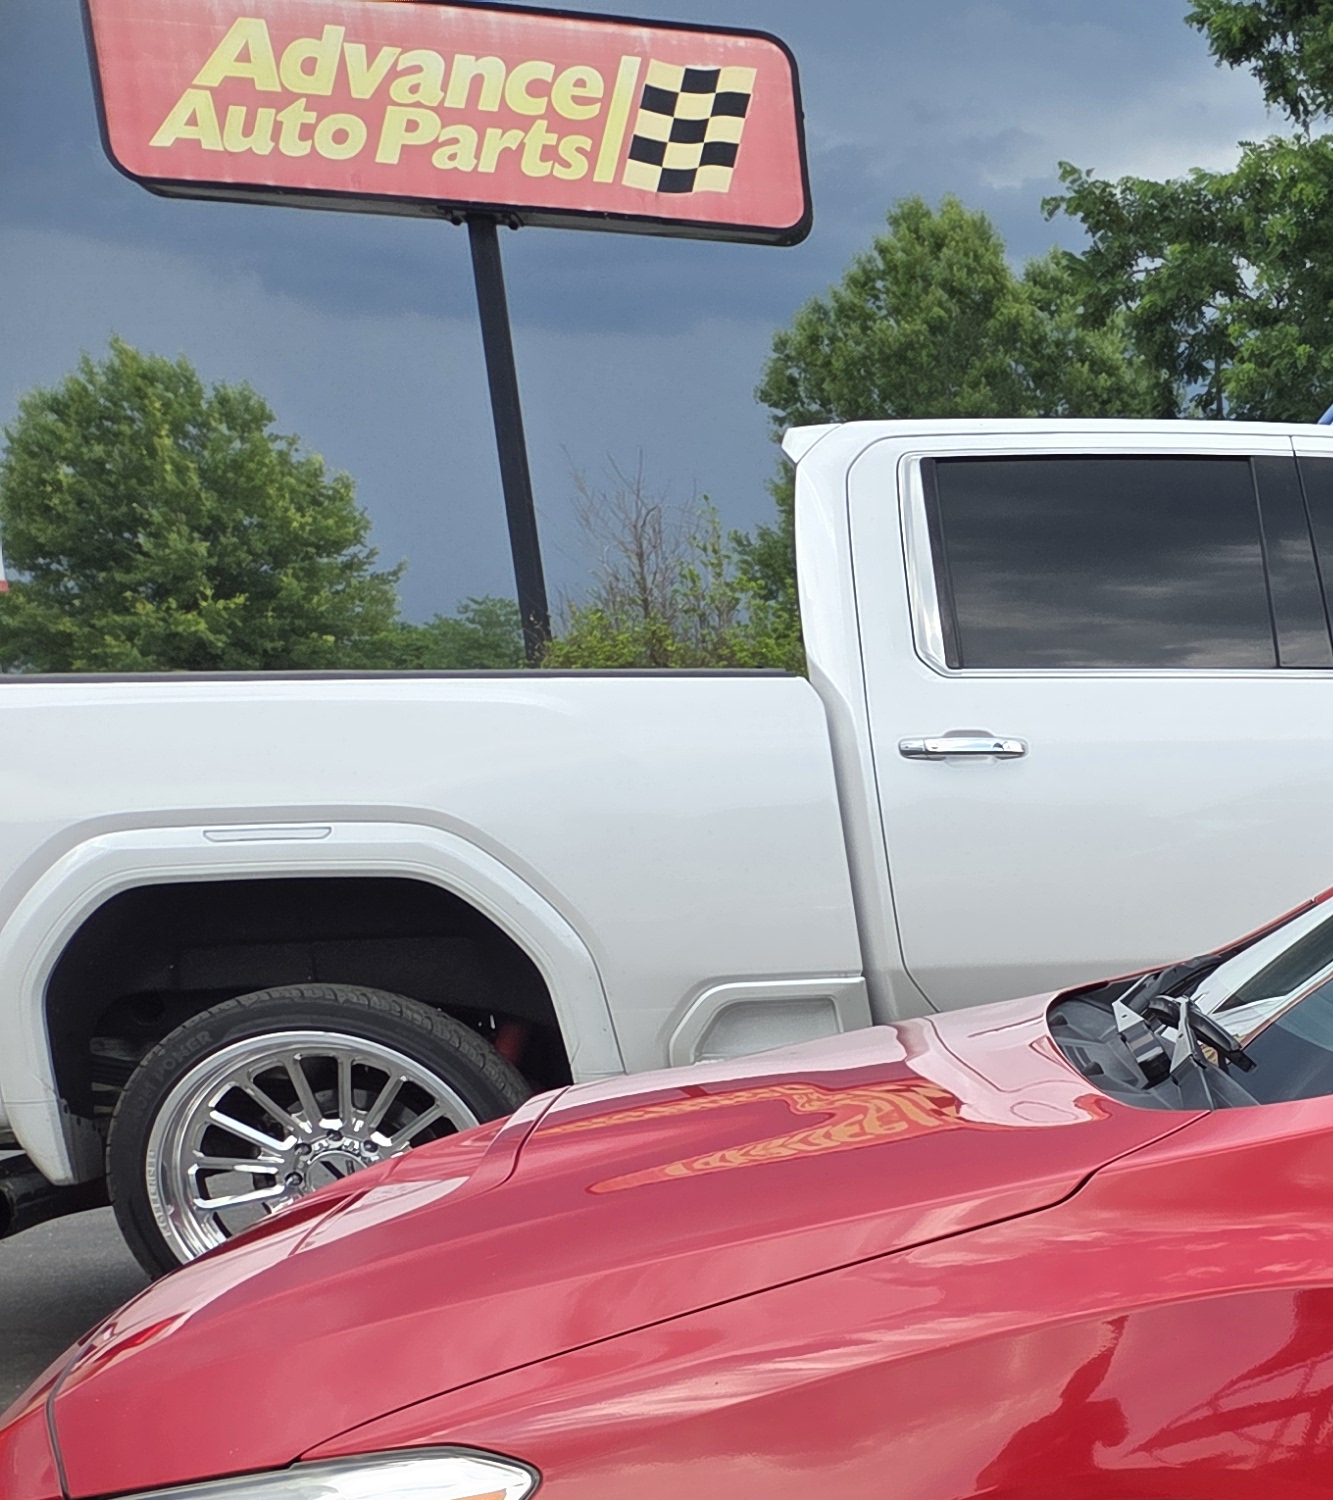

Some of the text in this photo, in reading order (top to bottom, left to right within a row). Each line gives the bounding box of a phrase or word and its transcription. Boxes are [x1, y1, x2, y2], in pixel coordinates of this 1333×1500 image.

[192, 17, 605, 121] Advance
[149, 88, 593, 180] Auto Parts
